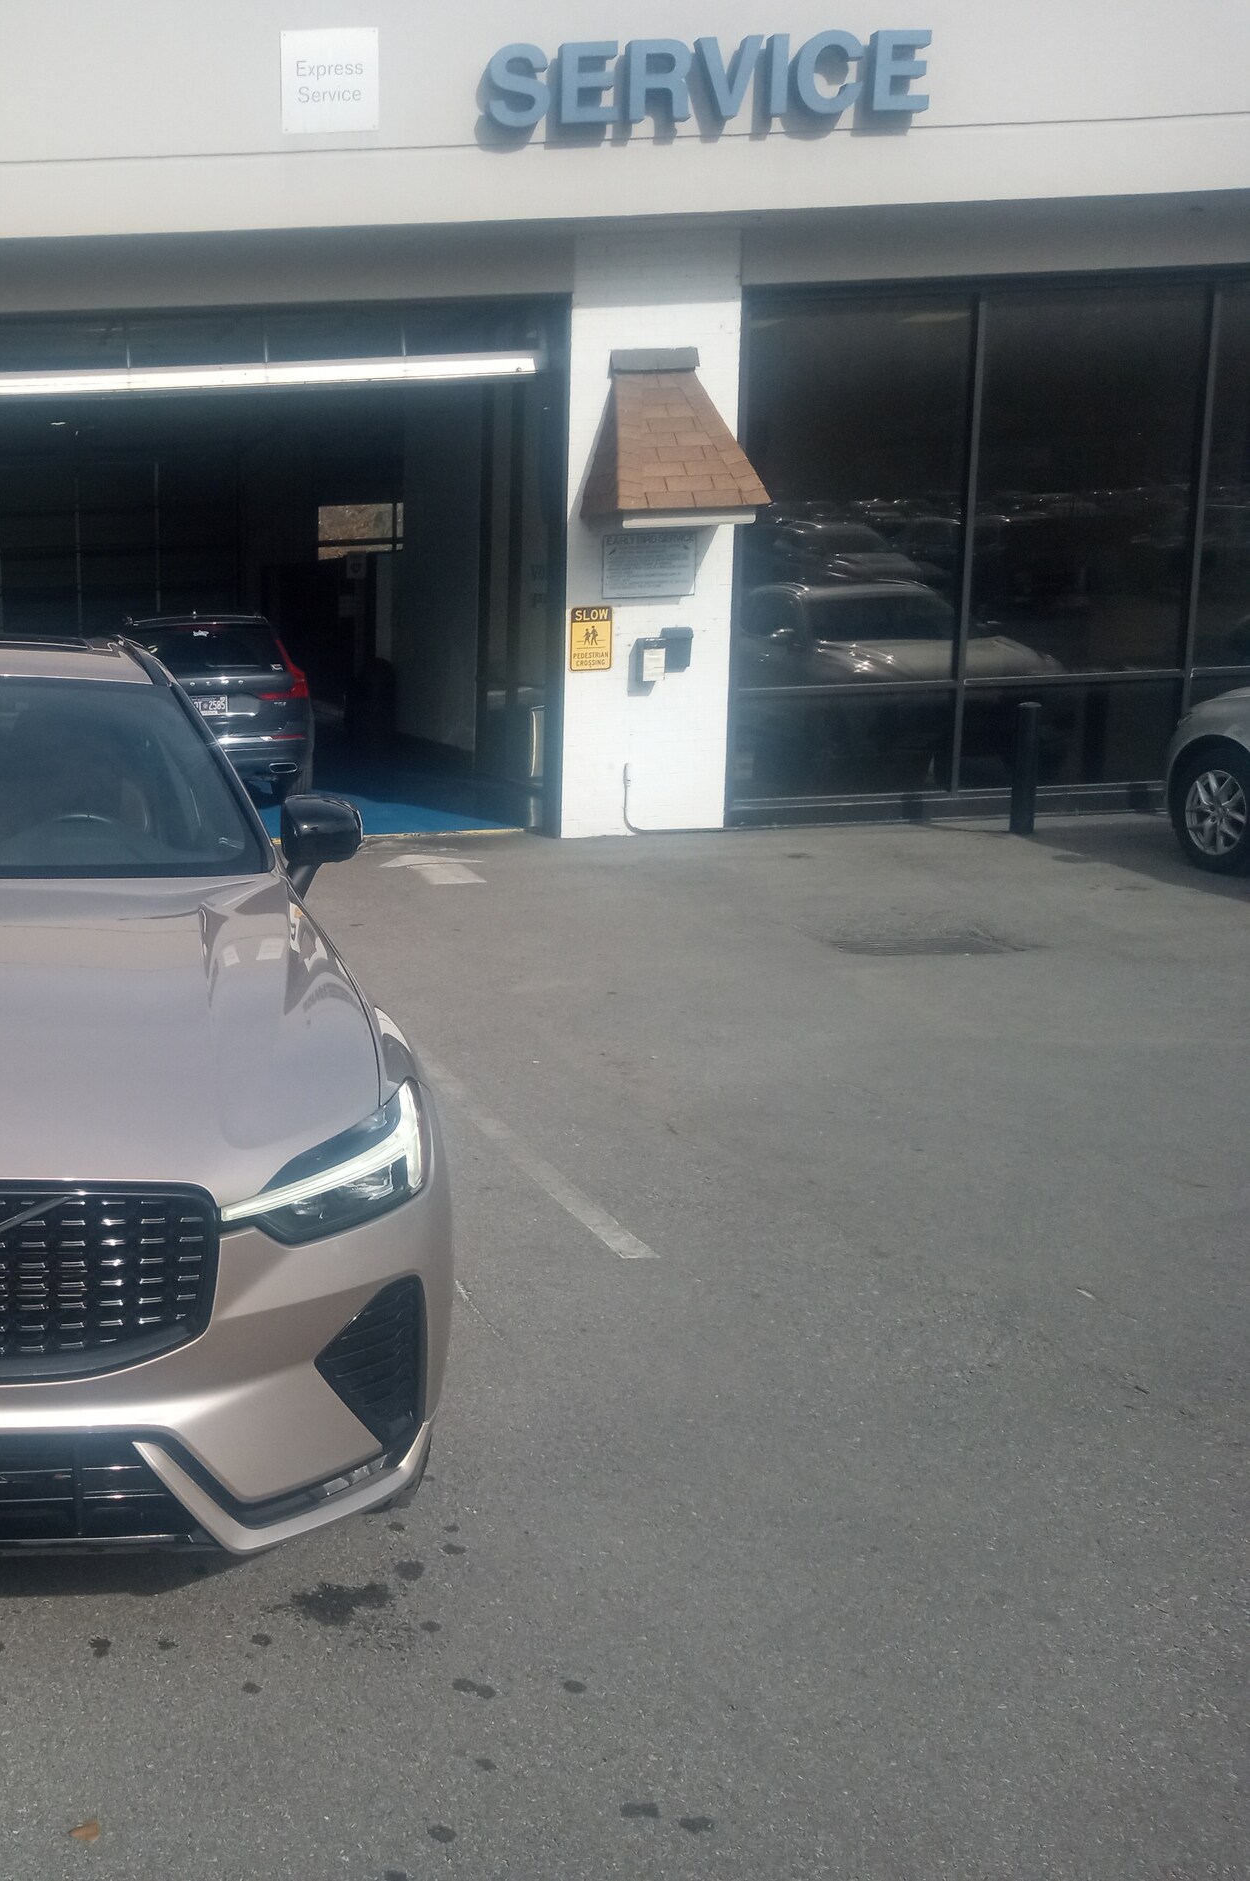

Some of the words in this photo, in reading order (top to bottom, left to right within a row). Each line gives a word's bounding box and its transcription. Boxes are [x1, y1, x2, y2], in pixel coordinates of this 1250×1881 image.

[296, 60, 364, 80] Express
[488, 29, 933, 129] SERVICE
[297, 86, 362, 103] Service
[575, 609, 609, 621] SLOW
[573, 651, 609, 659] PEDESTRIAN
[576, 659, 606, 667] CROSSING
